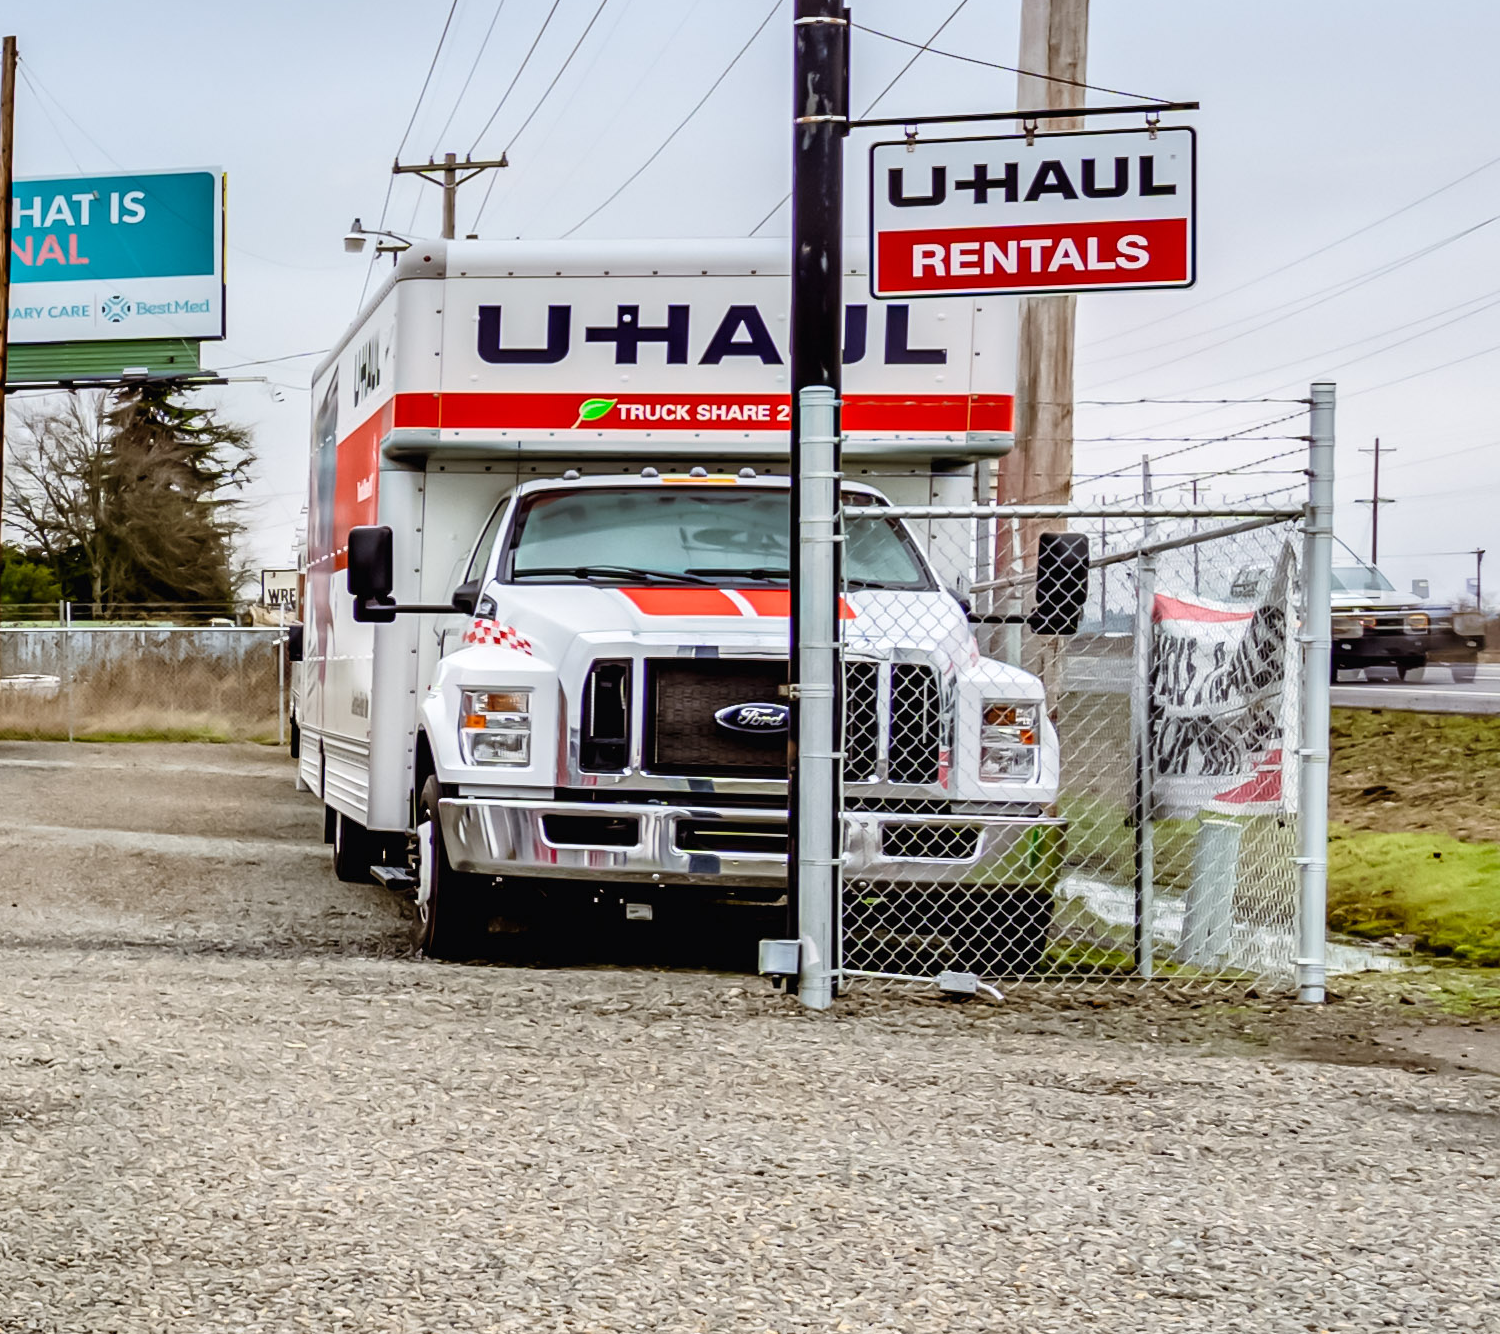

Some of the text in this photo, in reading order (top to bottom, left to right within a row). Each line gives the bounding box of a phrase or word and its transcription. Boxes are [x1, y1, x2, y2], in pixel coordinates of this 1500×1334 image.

[109, 191, 146, 224] IS
[912, 234, 1150, 278] RENTALS
[48, 304, 90, 319] CARE
[136, 298, 211, 317] BestMed
[616, 404, 691, 422] TRUCK
[696, 404, 771, 422] SHARE
[737, 707, 786, 726] Ford
